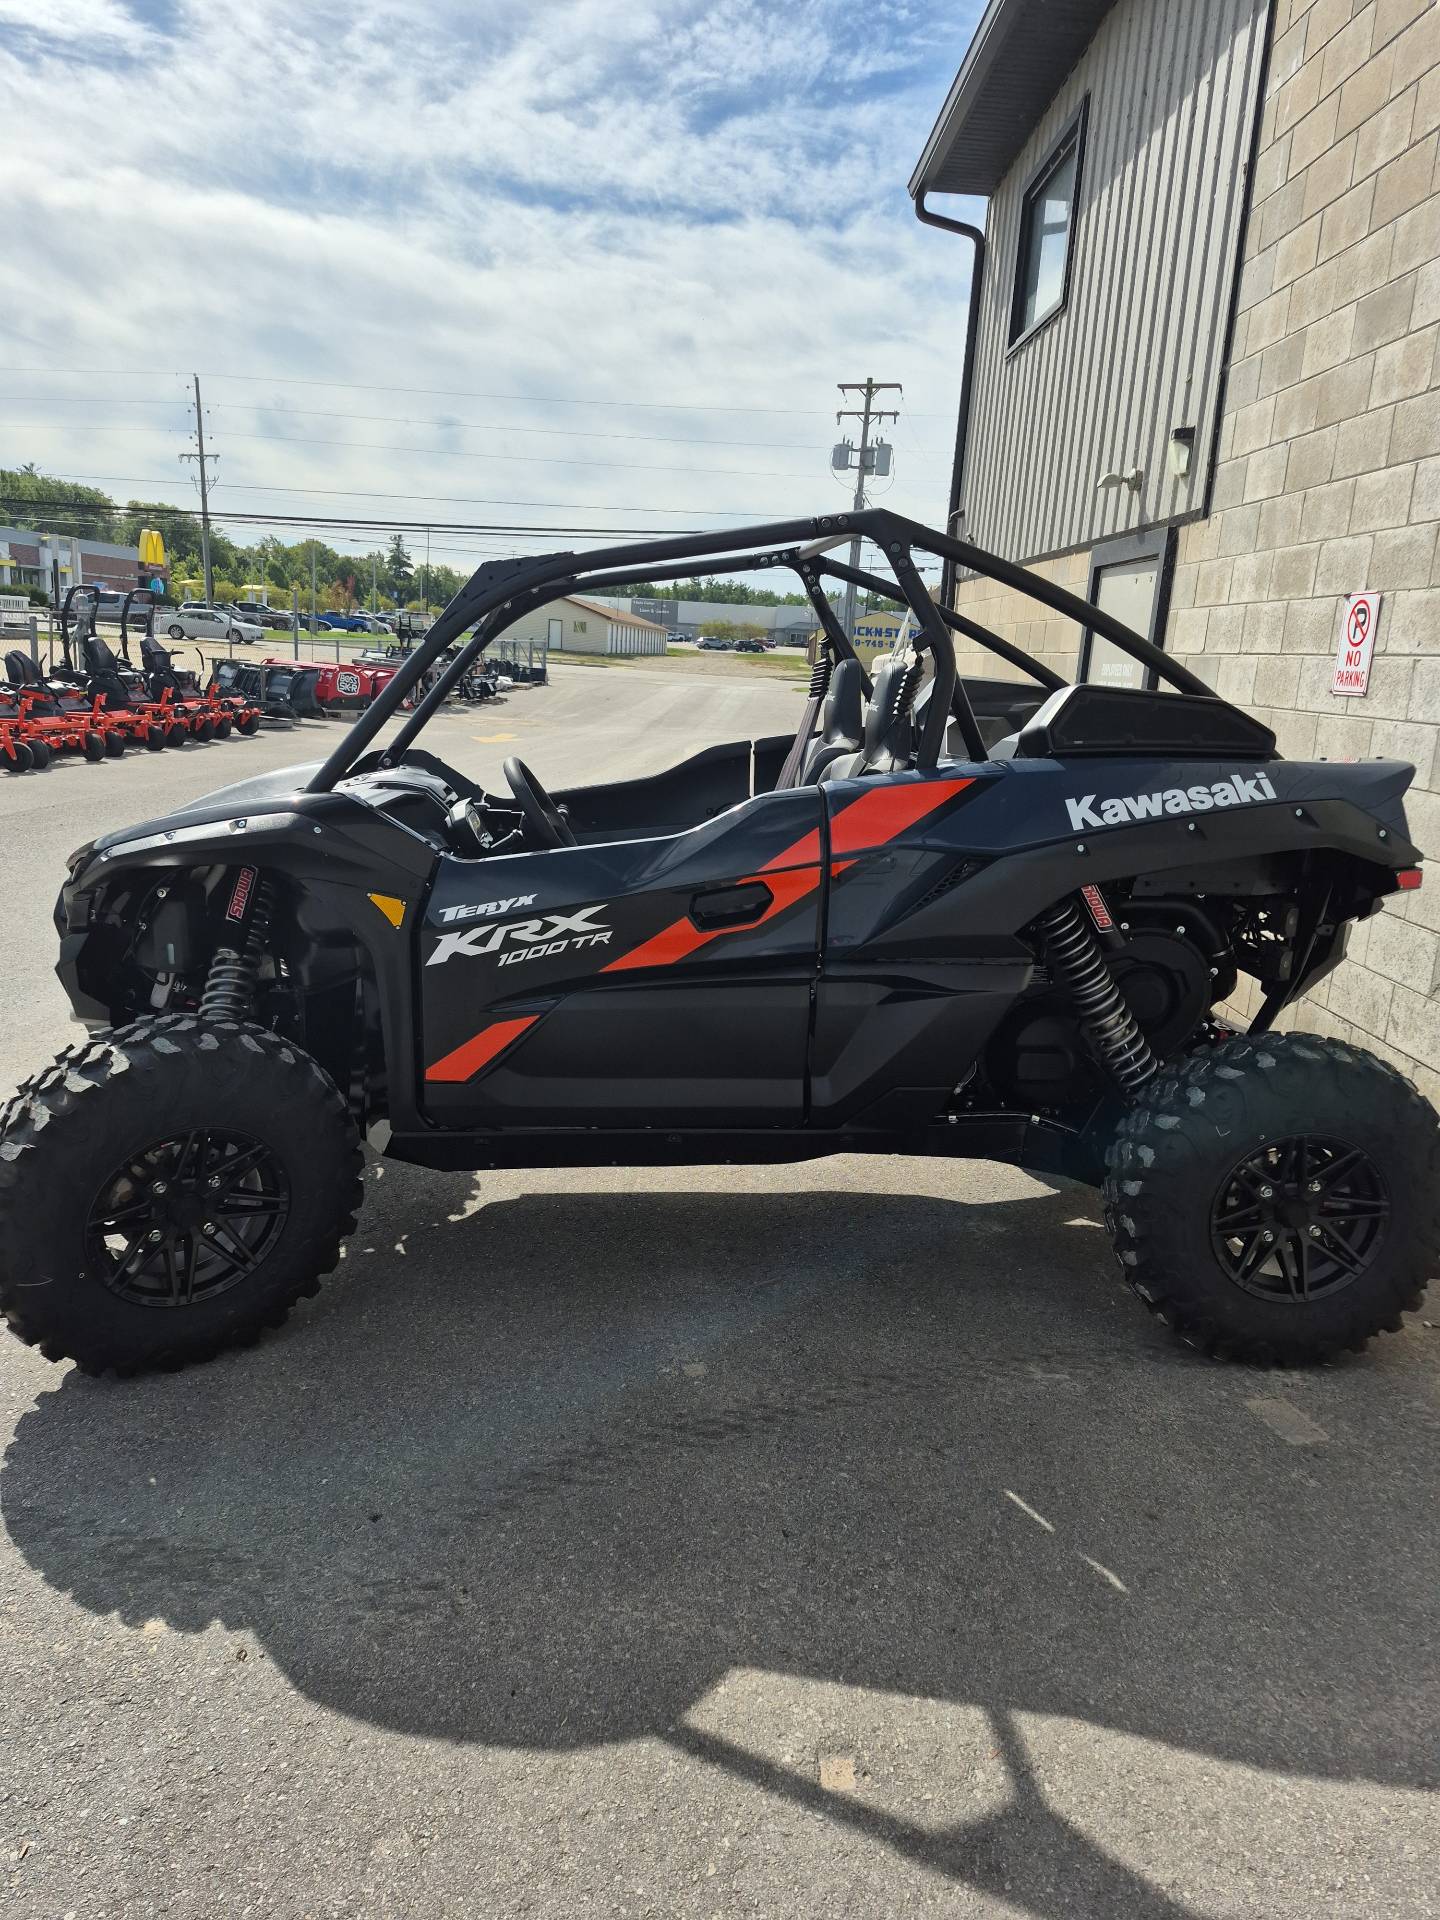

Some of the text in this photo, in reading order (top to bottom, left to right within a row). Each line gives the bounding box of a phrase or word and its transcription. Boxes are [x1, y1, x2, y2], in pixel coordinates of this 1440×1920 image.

[340, 674, 358, 684] BOSS
[1335, 670, 1366, 688] PARKING
[1346, 650, 1362, 667] NO
[1065, 771, 1278, 831] Kawasaki
[230, 868, 254, 920] SHOWA
[1081, 885, 1113, 928] HOWA
[425, 904, 612, 967] KRX
